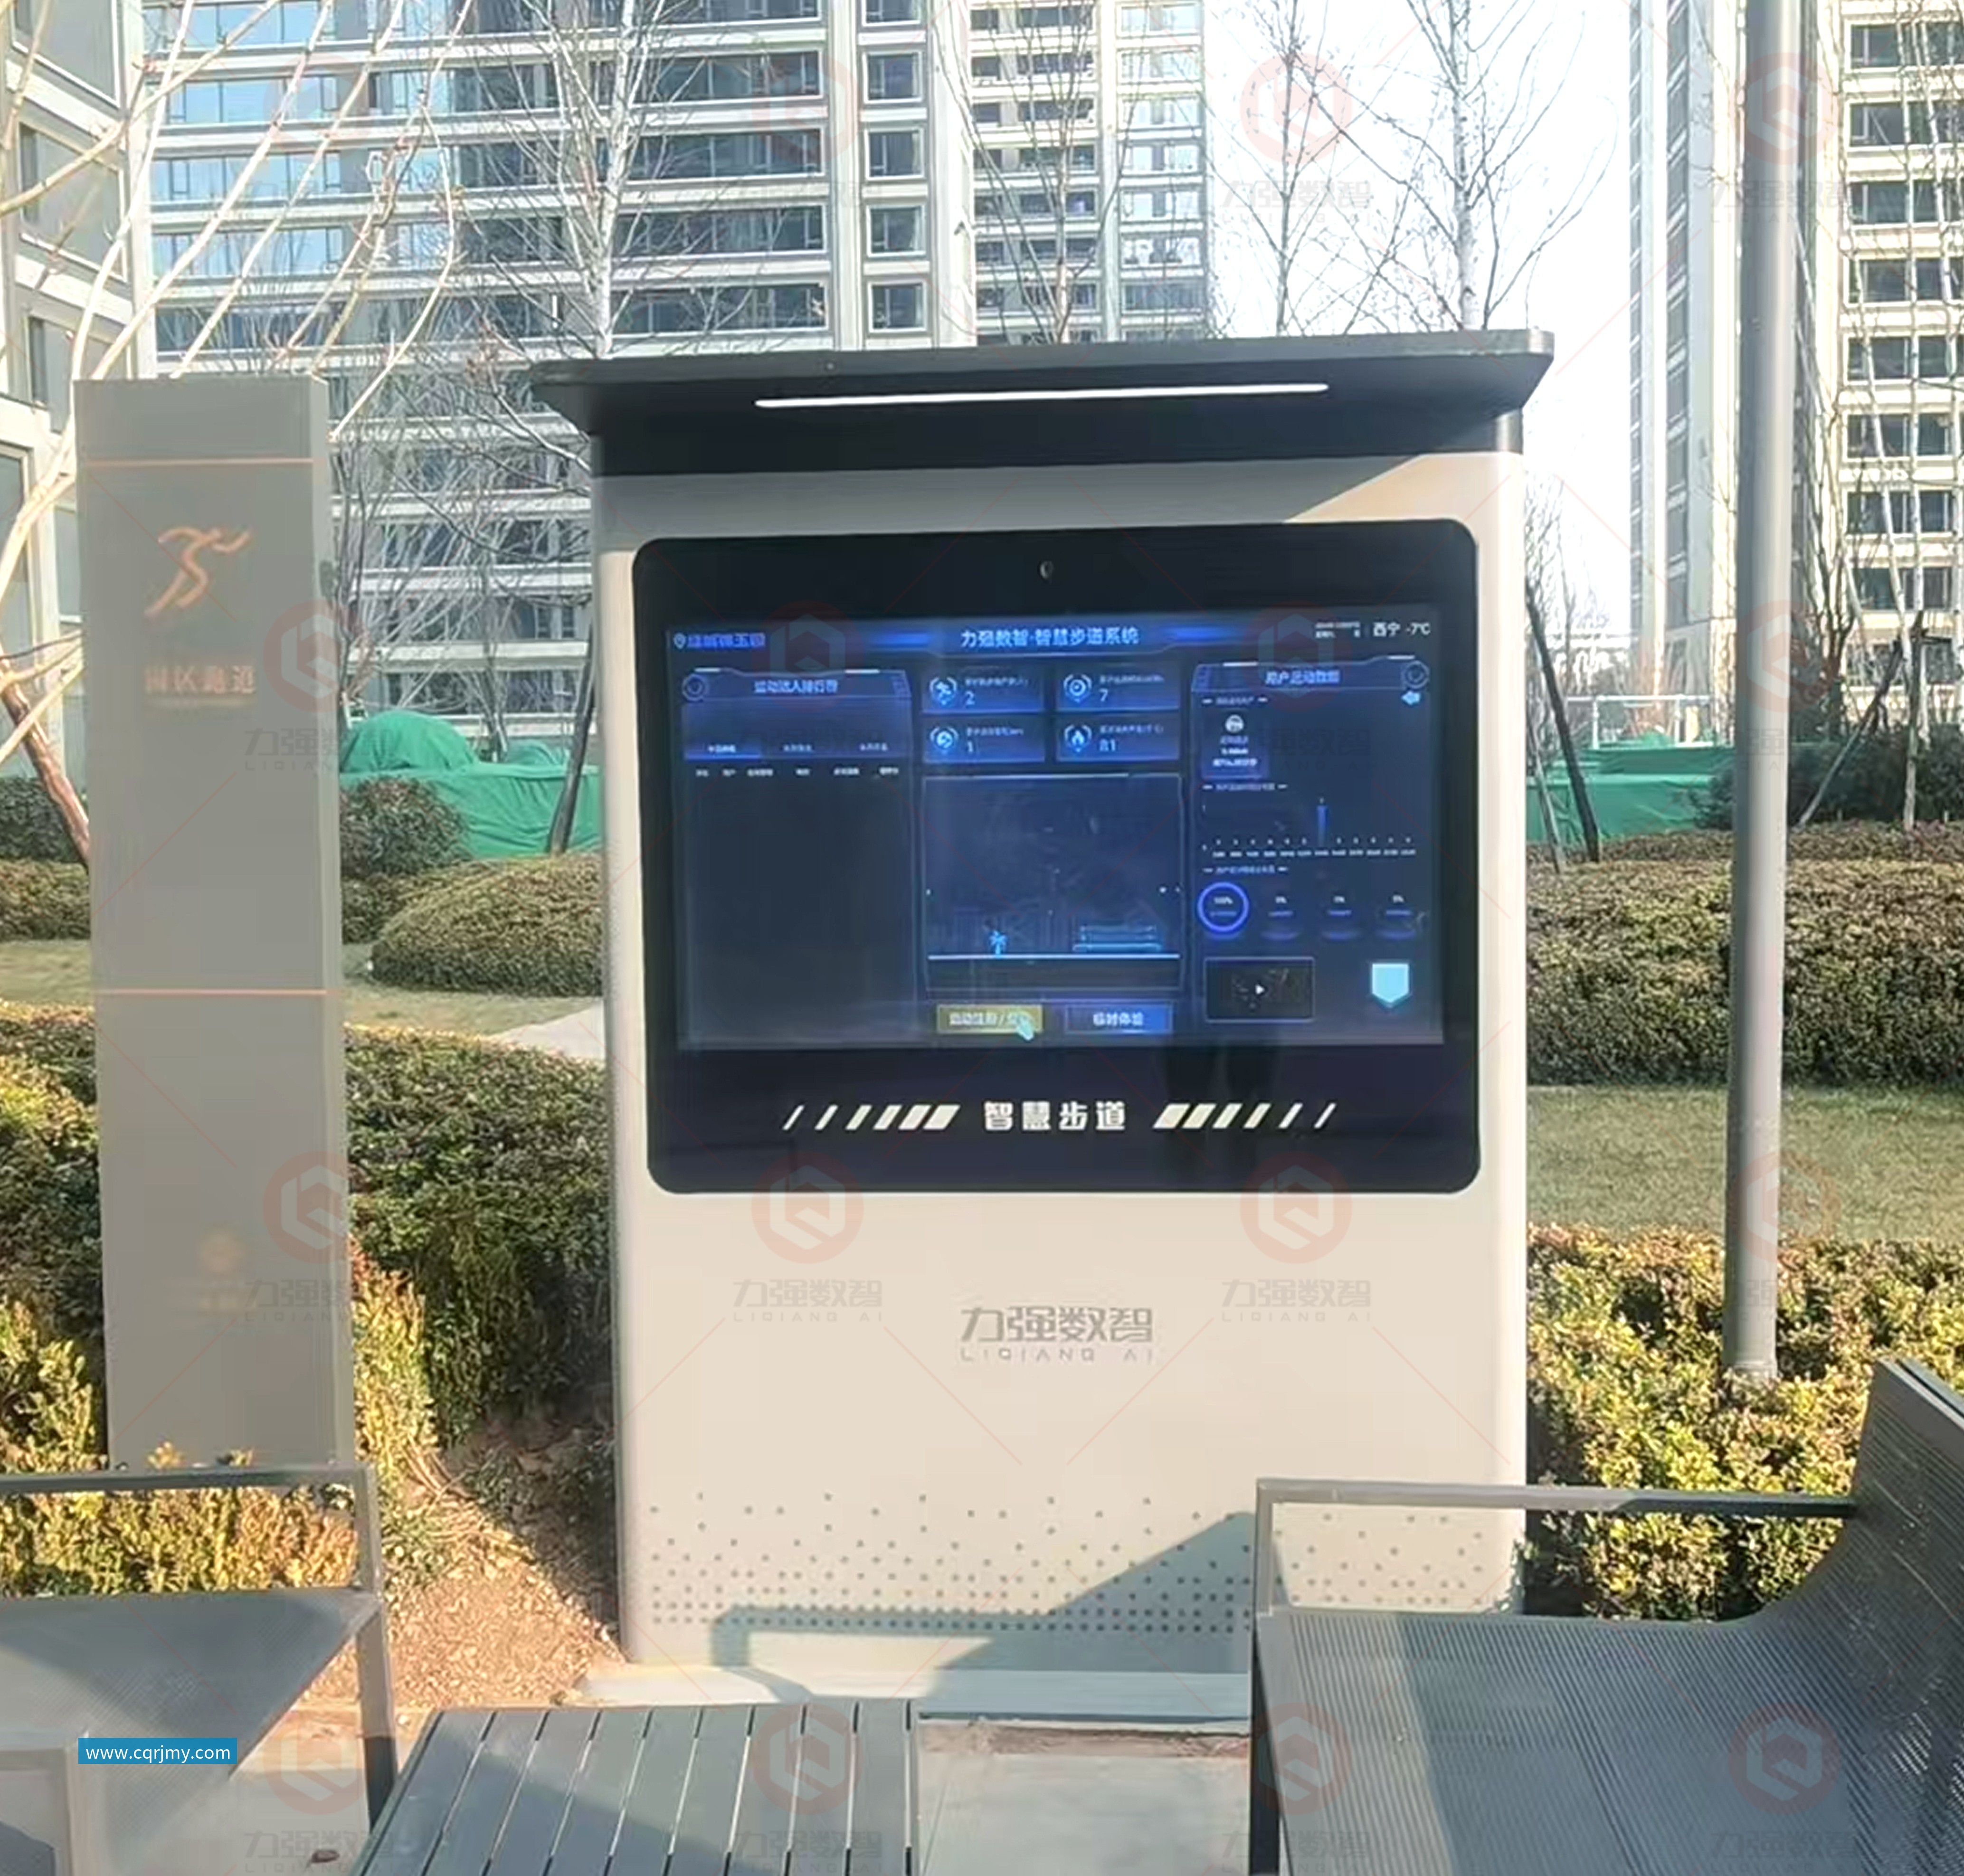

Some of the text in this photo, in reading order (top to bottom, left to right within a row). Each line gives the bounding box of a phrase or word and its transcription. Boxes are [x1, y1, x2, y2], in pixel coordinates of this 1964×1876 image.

[966, 691, 975, 705] 2
[1099, 688, 1108, 701] 7
[984, 1101, 1126, 1131] 智慧步道
[960, 1306, 1153, 1342] 力强数智
[961, 1347, 1153, 1362] LIQIANG AI
